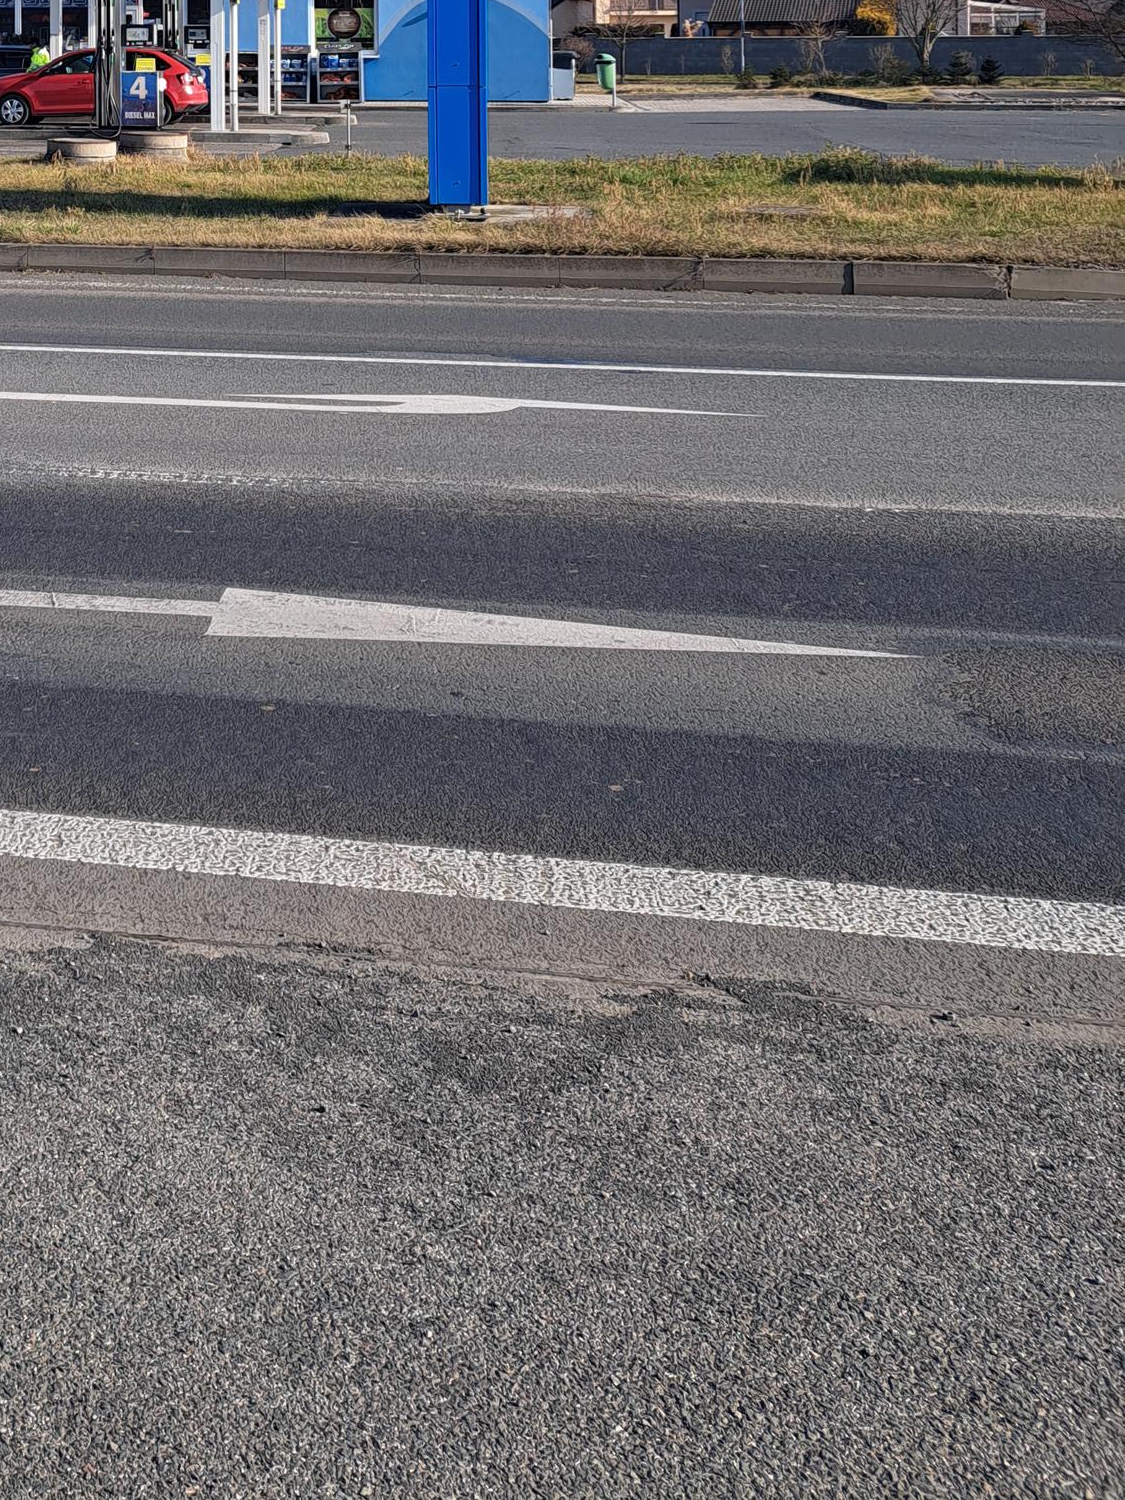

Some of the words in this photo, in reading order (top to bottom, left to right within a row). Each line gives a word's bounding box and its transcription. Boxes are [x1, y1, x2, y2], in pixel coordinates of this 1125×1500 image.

[129, 76, 148, 100] 4
[125, 111, 143, 119] DIESEL
[144, 111, 155, 119] MAX
